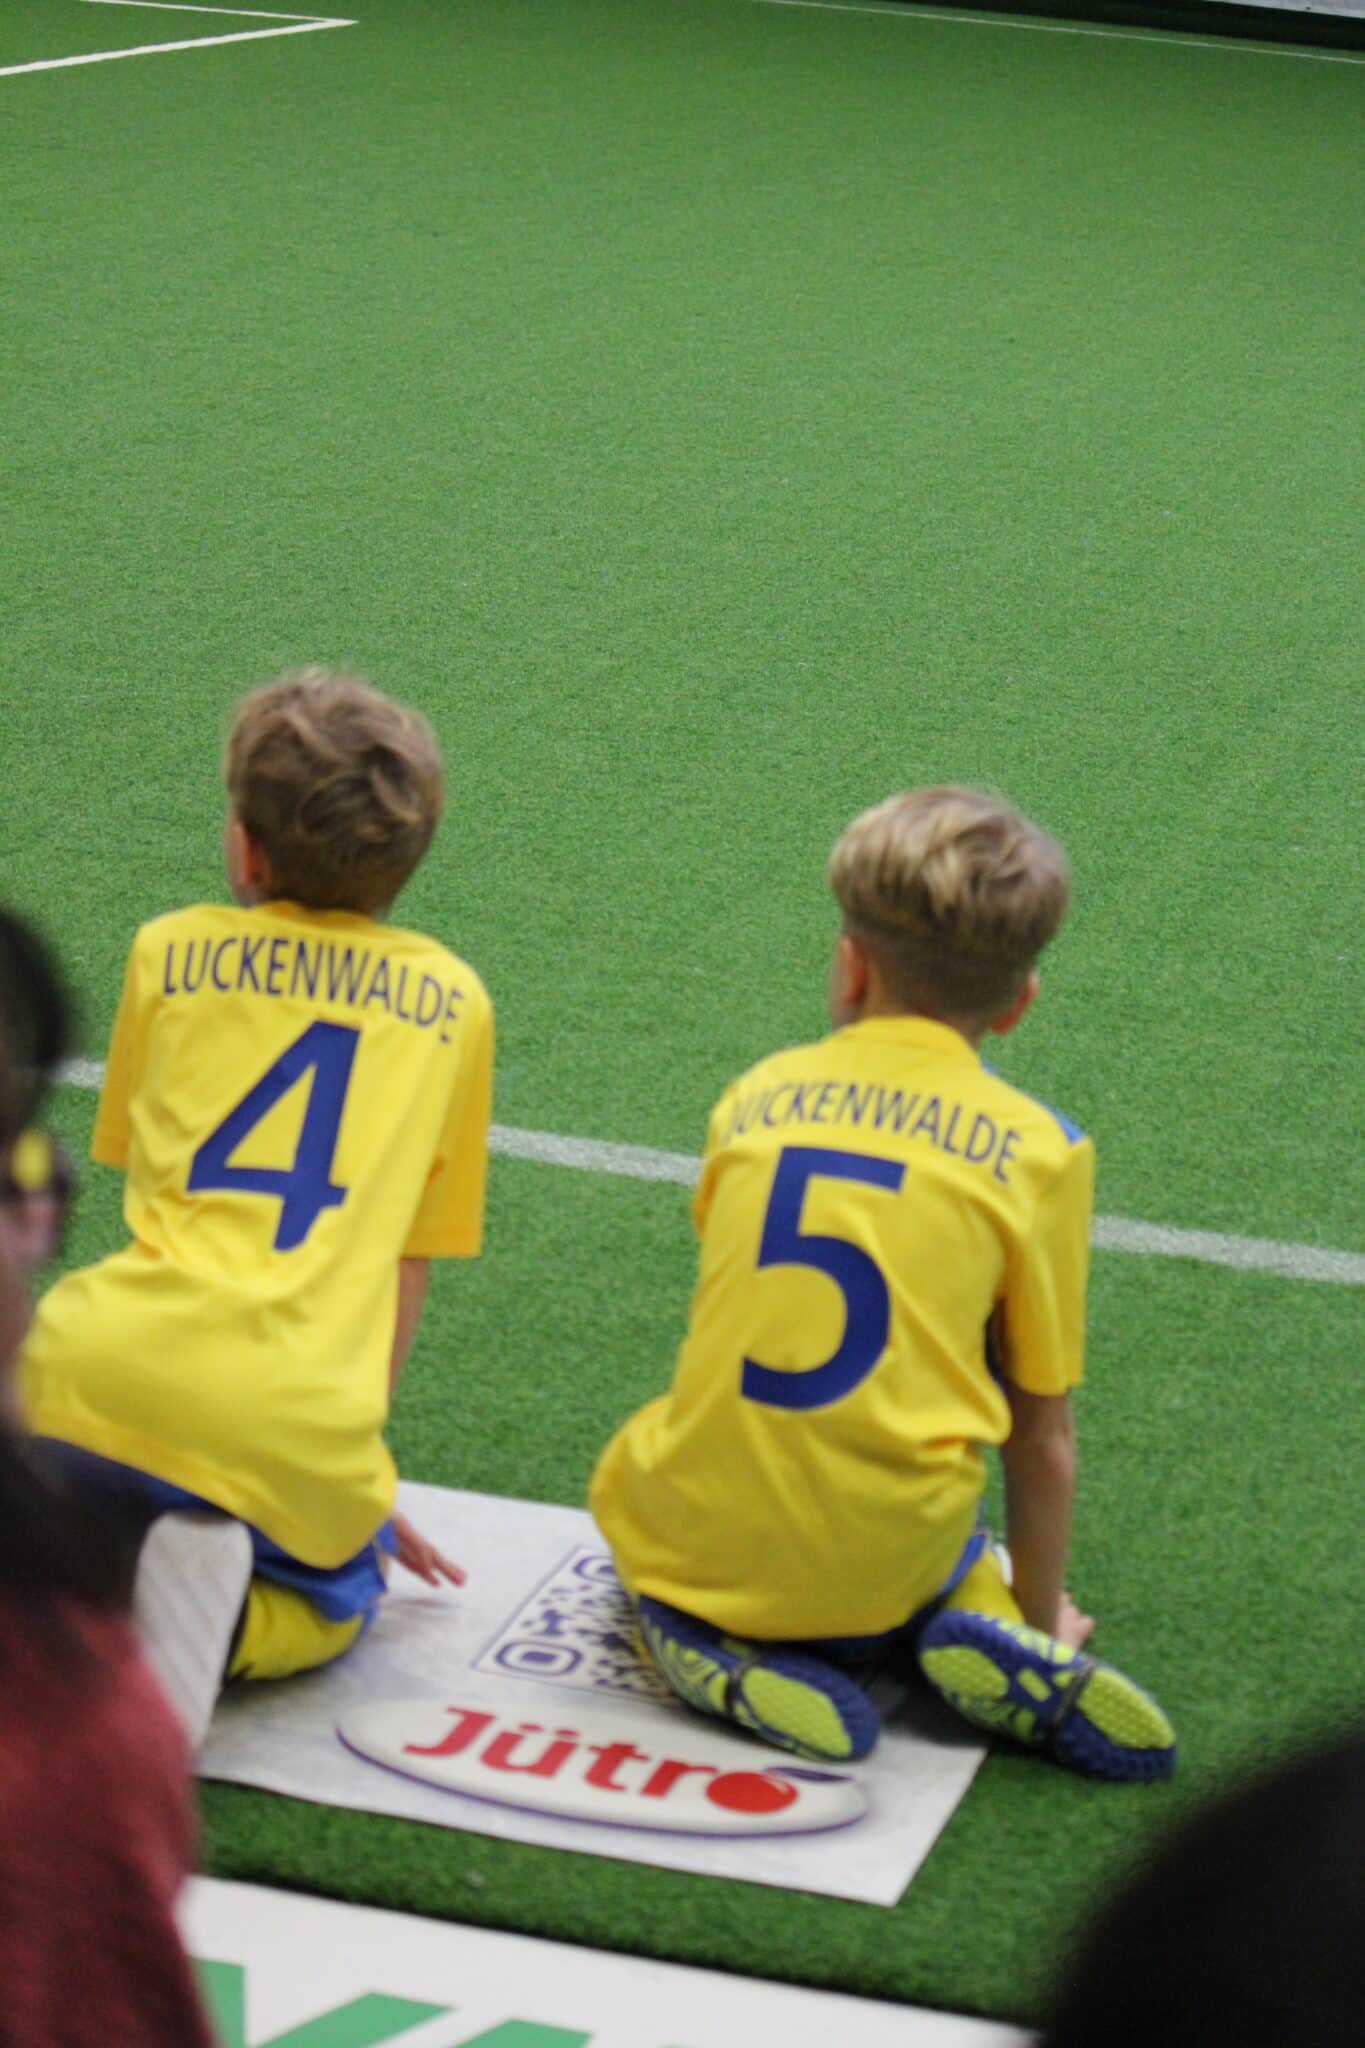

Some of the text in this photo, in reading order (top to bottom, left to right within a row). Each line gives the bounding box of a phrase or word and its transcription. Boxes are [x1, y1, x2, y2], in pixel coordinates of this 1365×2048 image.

[163, 936, 464, 1044] LUCKENWALDE
[186, 1019, 361, 1253] 4
[722, 1080, 1020, 1183] UCKENWALDE
[741, 1146, 907, 1413] 5
[402, 1705, 800, 1815] Jütro
